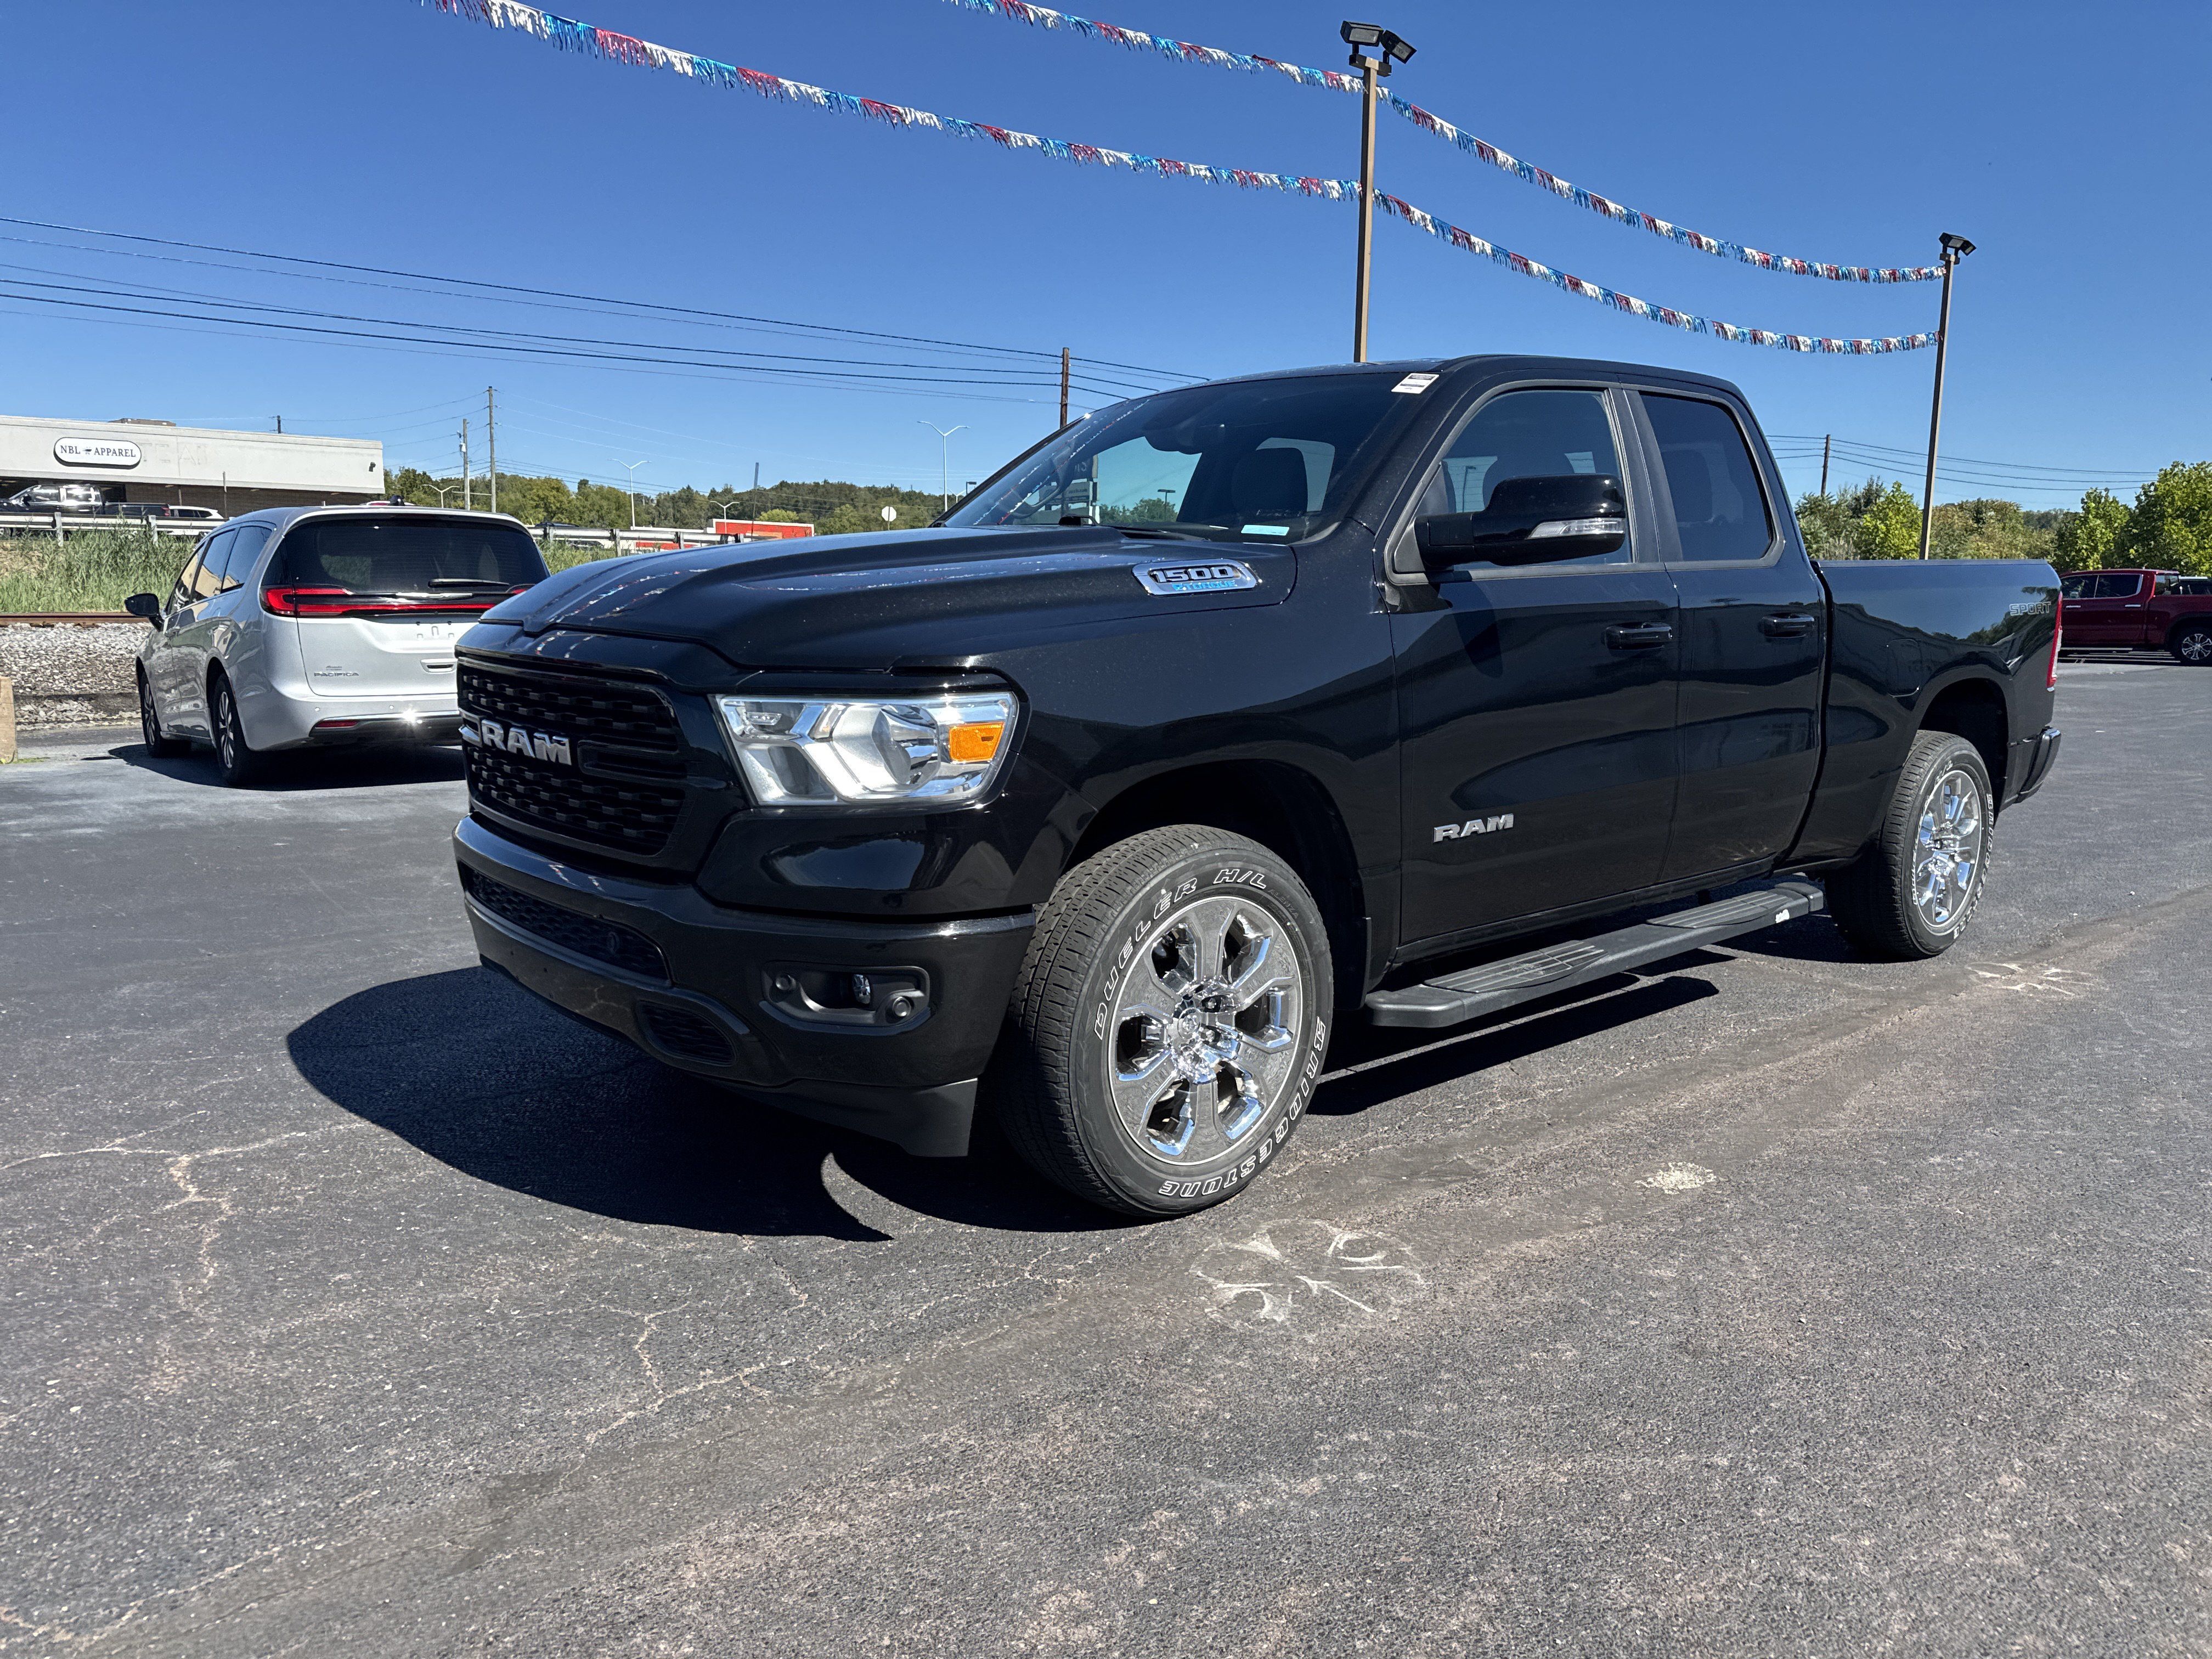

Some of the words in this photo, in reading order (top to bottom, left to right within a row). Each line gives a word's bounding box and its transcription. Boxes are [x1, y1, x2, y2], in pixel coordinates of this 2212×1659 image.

[60, 445, 81, 455] NBL
[94, 447, 136, 458] APPAREL
[1153, 565, 1234, 583] 1500
[2009, 601, 2052, 616] SPORT
[481, 719, 572, 766] RAM
[1433, 813, 1514, 843] RAM
[1094, 877, 1198, 1041] DUELER
[1213, 868, 1267, 889] H/L
[1158, 1016, 1326, 1198] BRIDGESTONE
